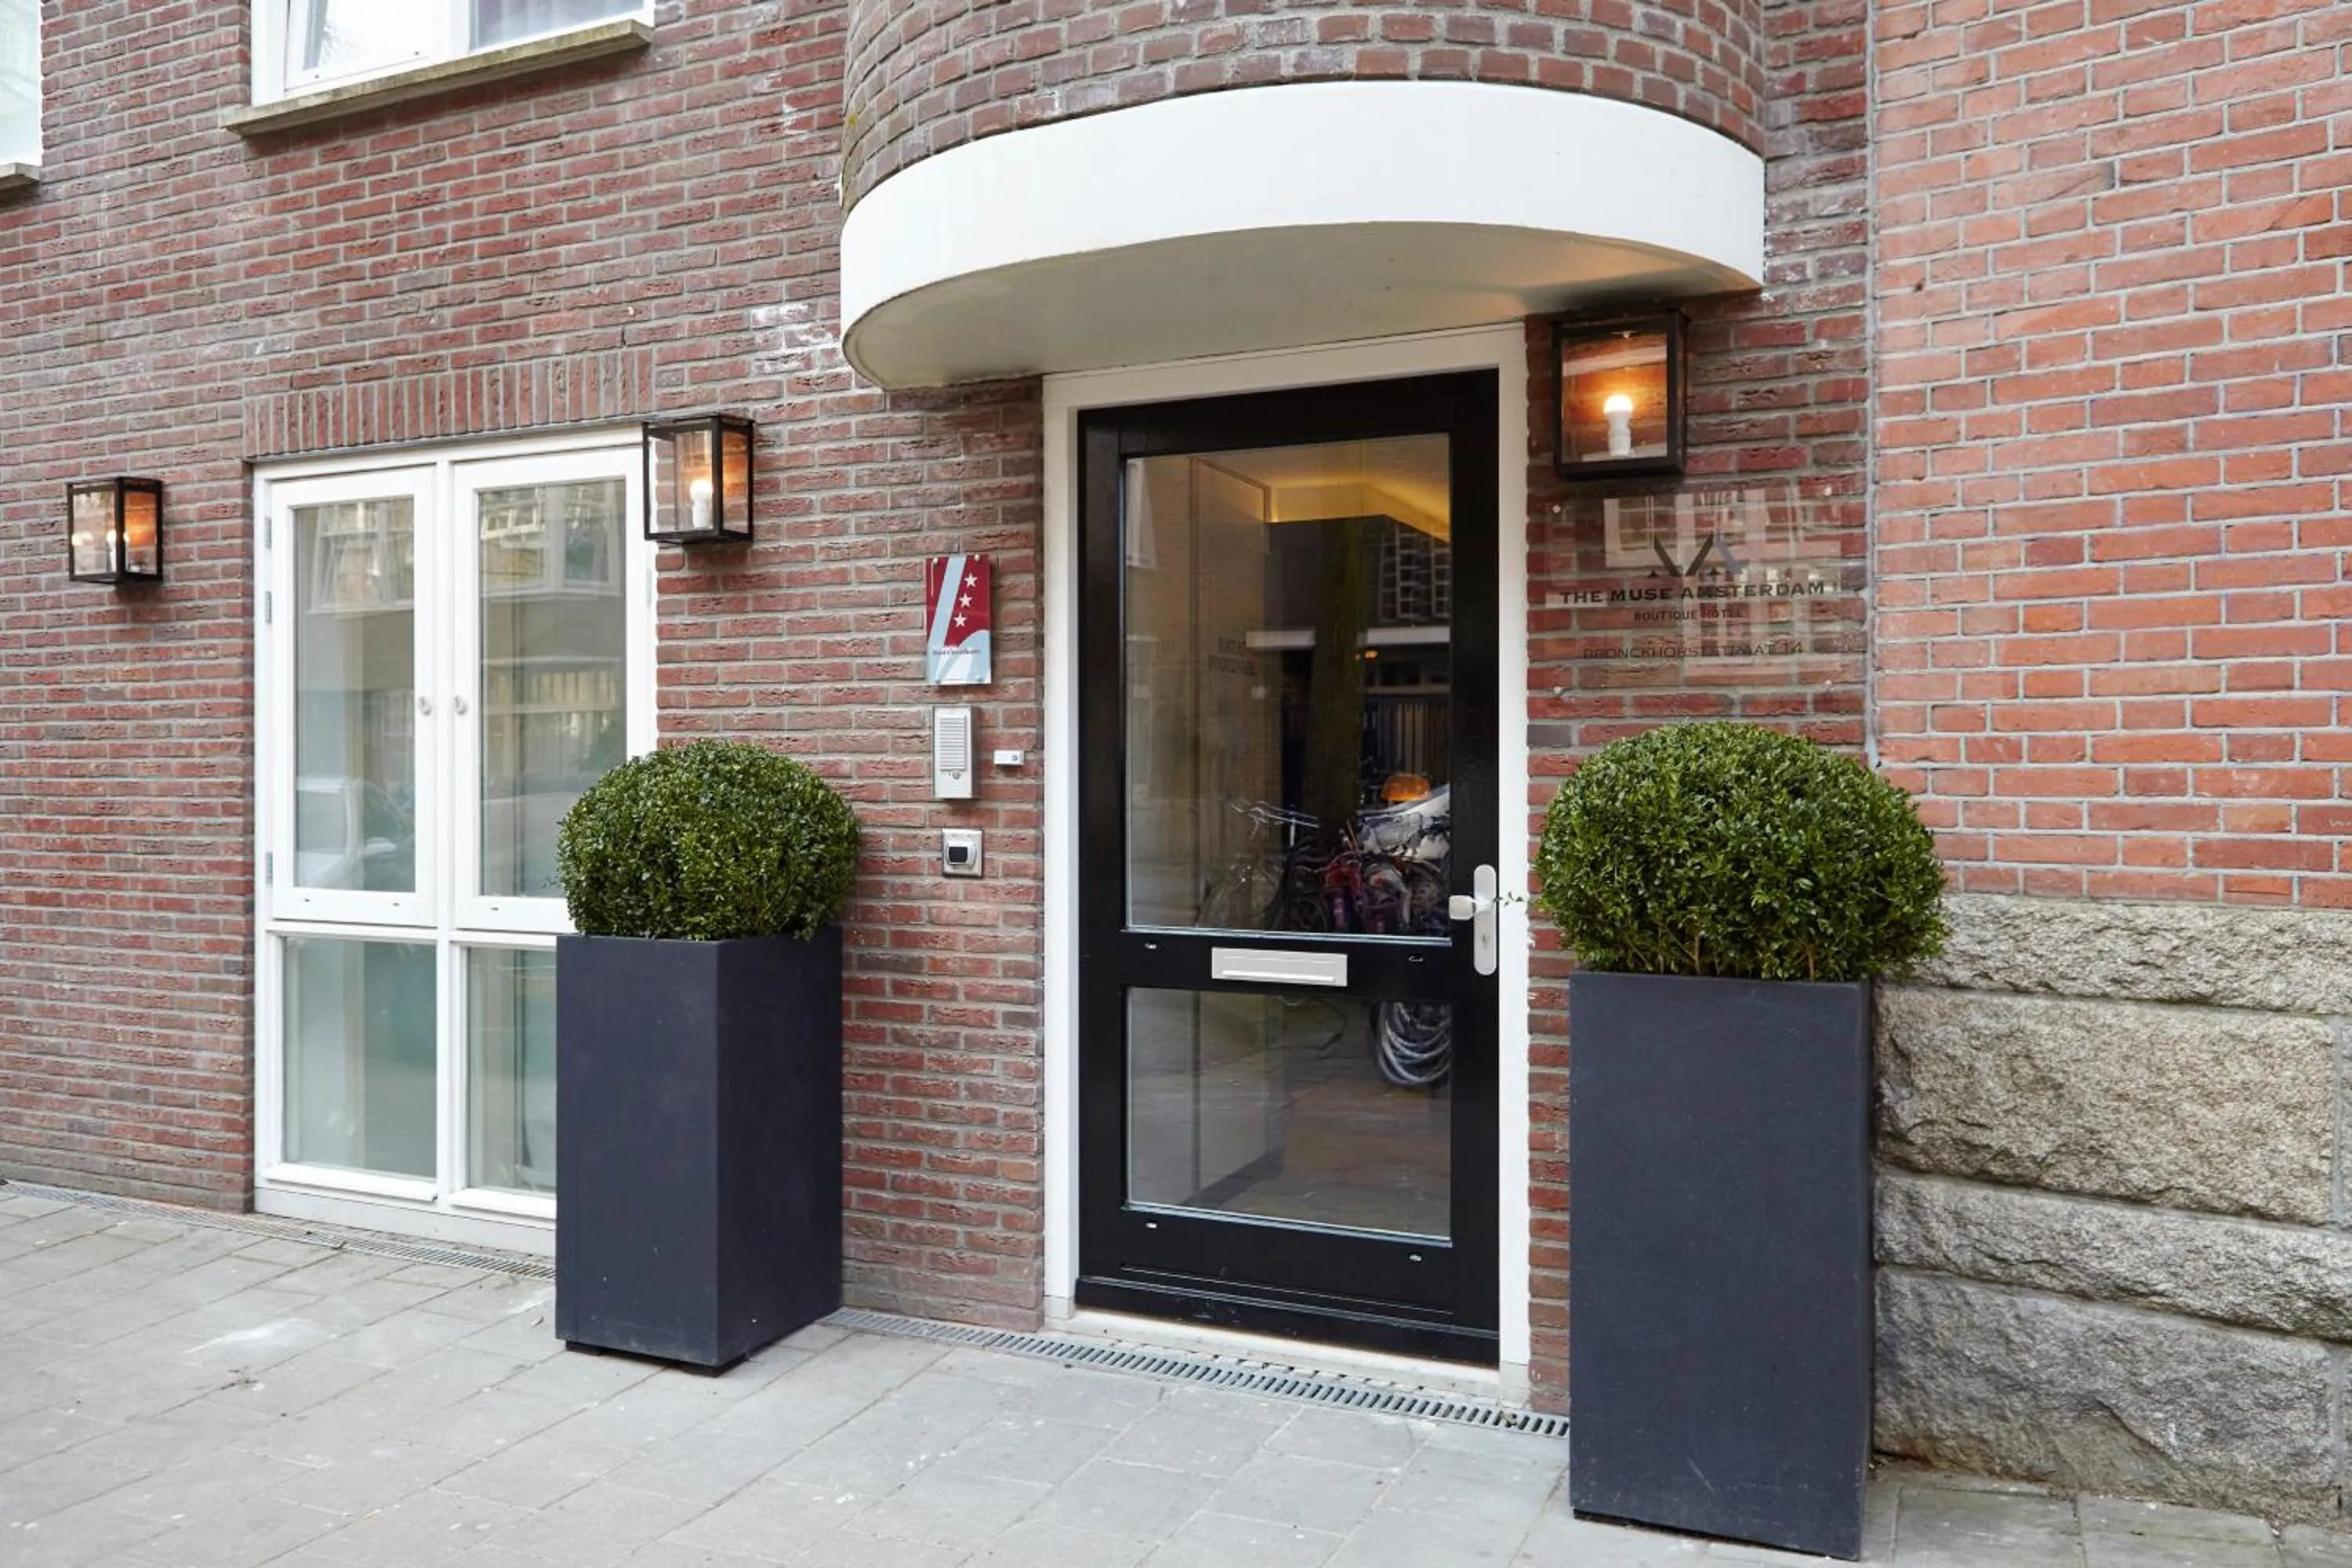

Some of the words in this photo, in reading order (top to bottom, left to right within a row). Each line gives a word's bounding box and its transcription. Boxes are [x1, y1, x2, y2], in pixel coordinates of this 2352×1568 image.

[1559, 590, 1603, 604] THE
[1610, 587, 1671, 601] MUSE
[1680, 581, 1824, 600] AMSTERDAM
[1634, 609, 1697, 621] BOUTIQUE
